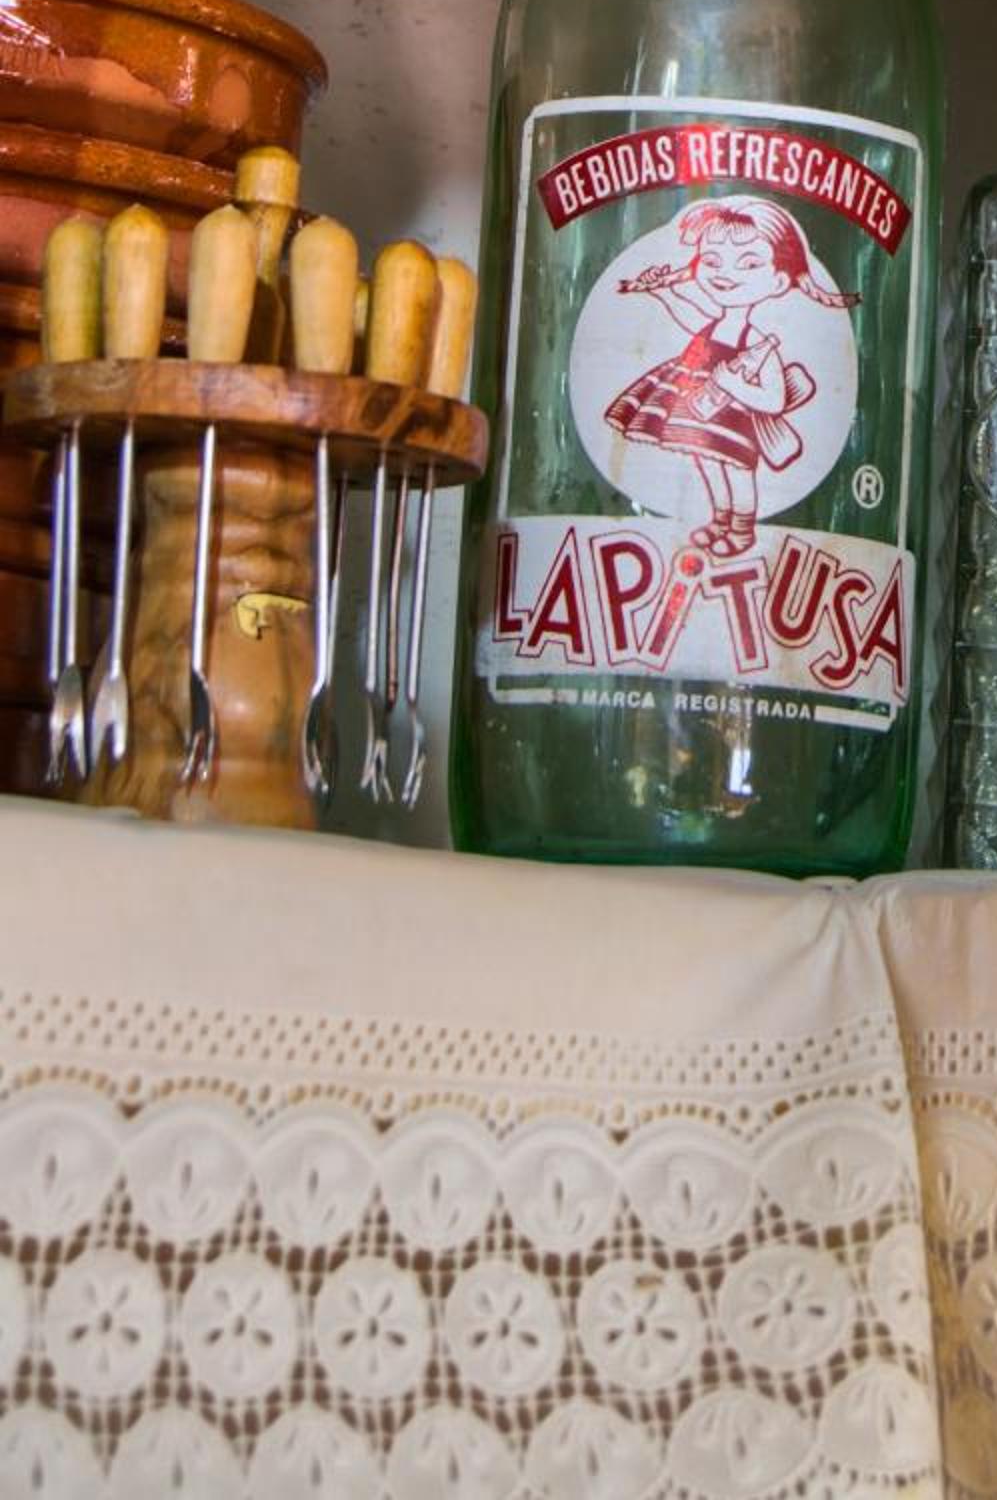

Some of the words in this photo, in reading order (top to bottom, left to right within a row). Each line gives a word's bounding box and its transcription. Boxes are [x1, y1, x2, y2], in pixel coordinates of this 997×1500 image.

[554, 135, 676, 216] BEBIDAS
[688, 130, 898, 240] REFRESCANTES
[582, 691, 656, 709] MARCA
[674, 694, 812, 721] REGISTRADA
